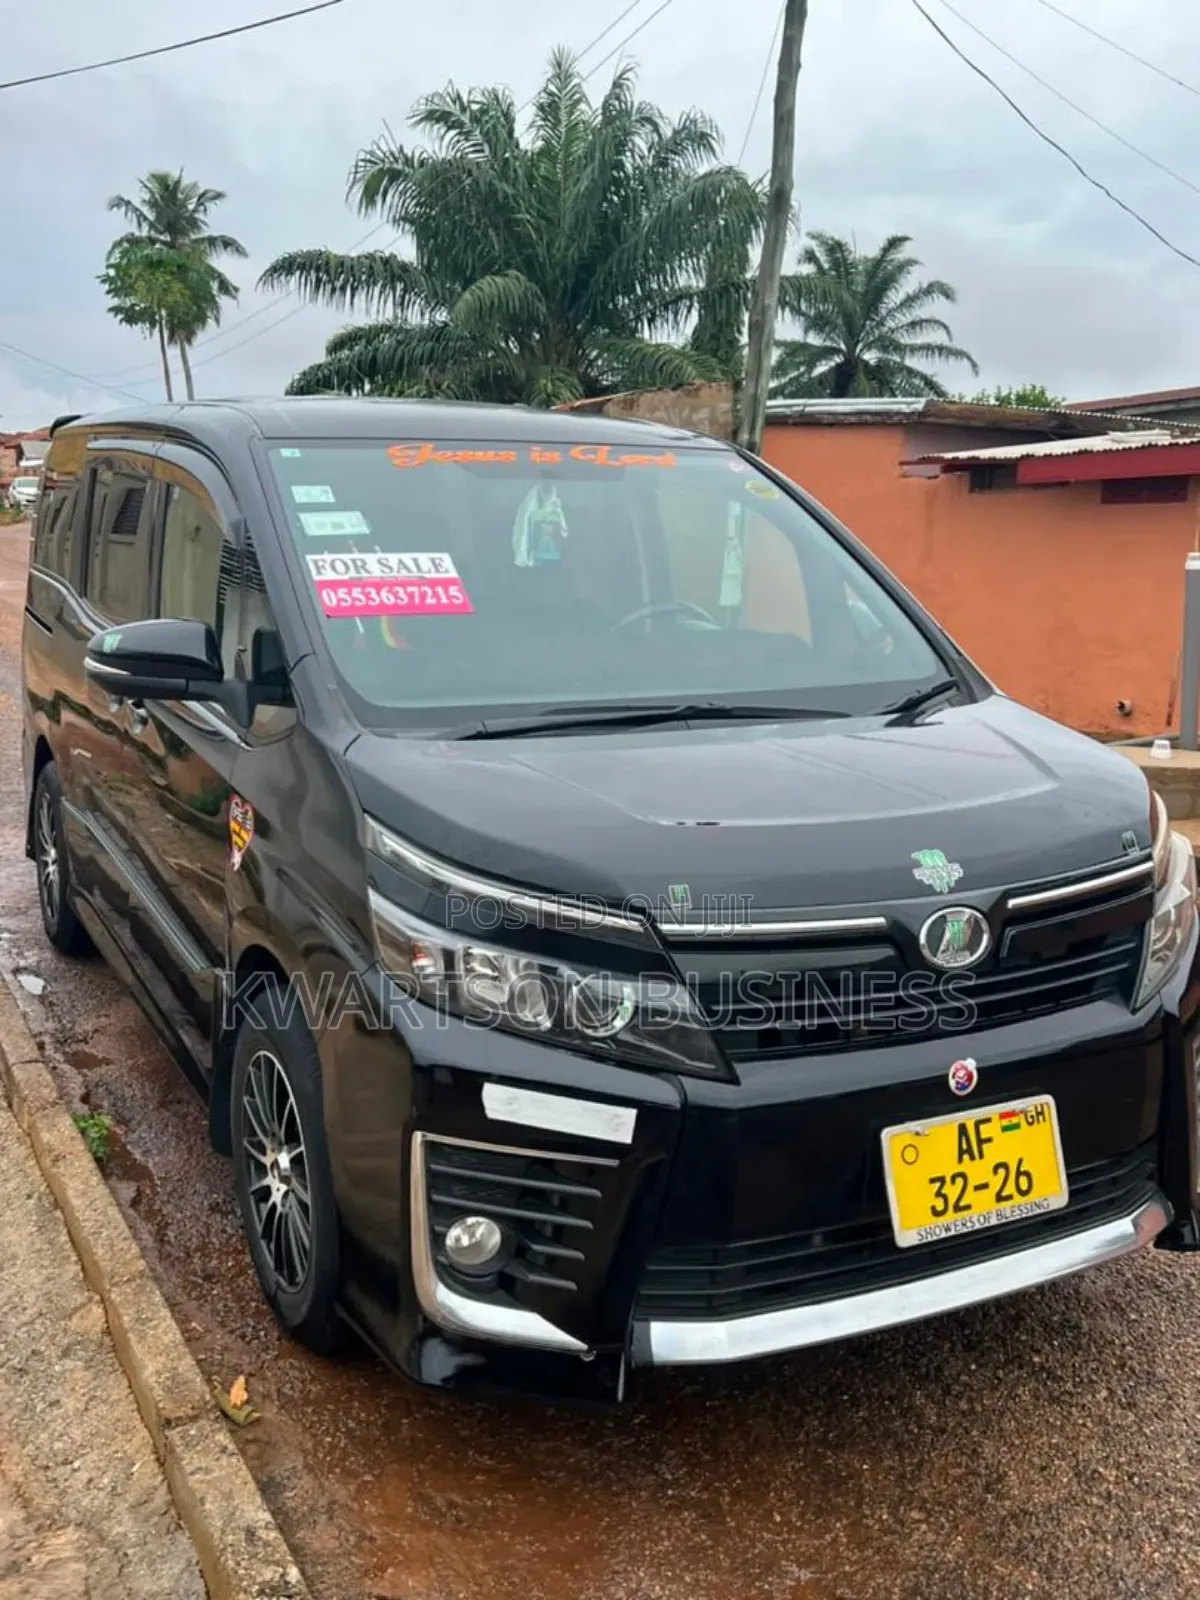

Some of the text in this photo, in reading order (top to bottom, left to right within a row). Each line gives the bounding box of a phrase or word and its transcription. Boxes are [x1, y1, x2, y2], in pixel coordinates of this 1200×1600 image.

[387, 442, 676, 468] Jesus is Lord
[310, 556, 450, 576] FOR SALE
[321, 585, 464, 608] 0553637215
[957, 1103, 1047, 1164] AF GH
[928, 1156, 1034, 1218] 32-26
[916, 1198, 1051, 1242] SHOWERS OF BLESSING
